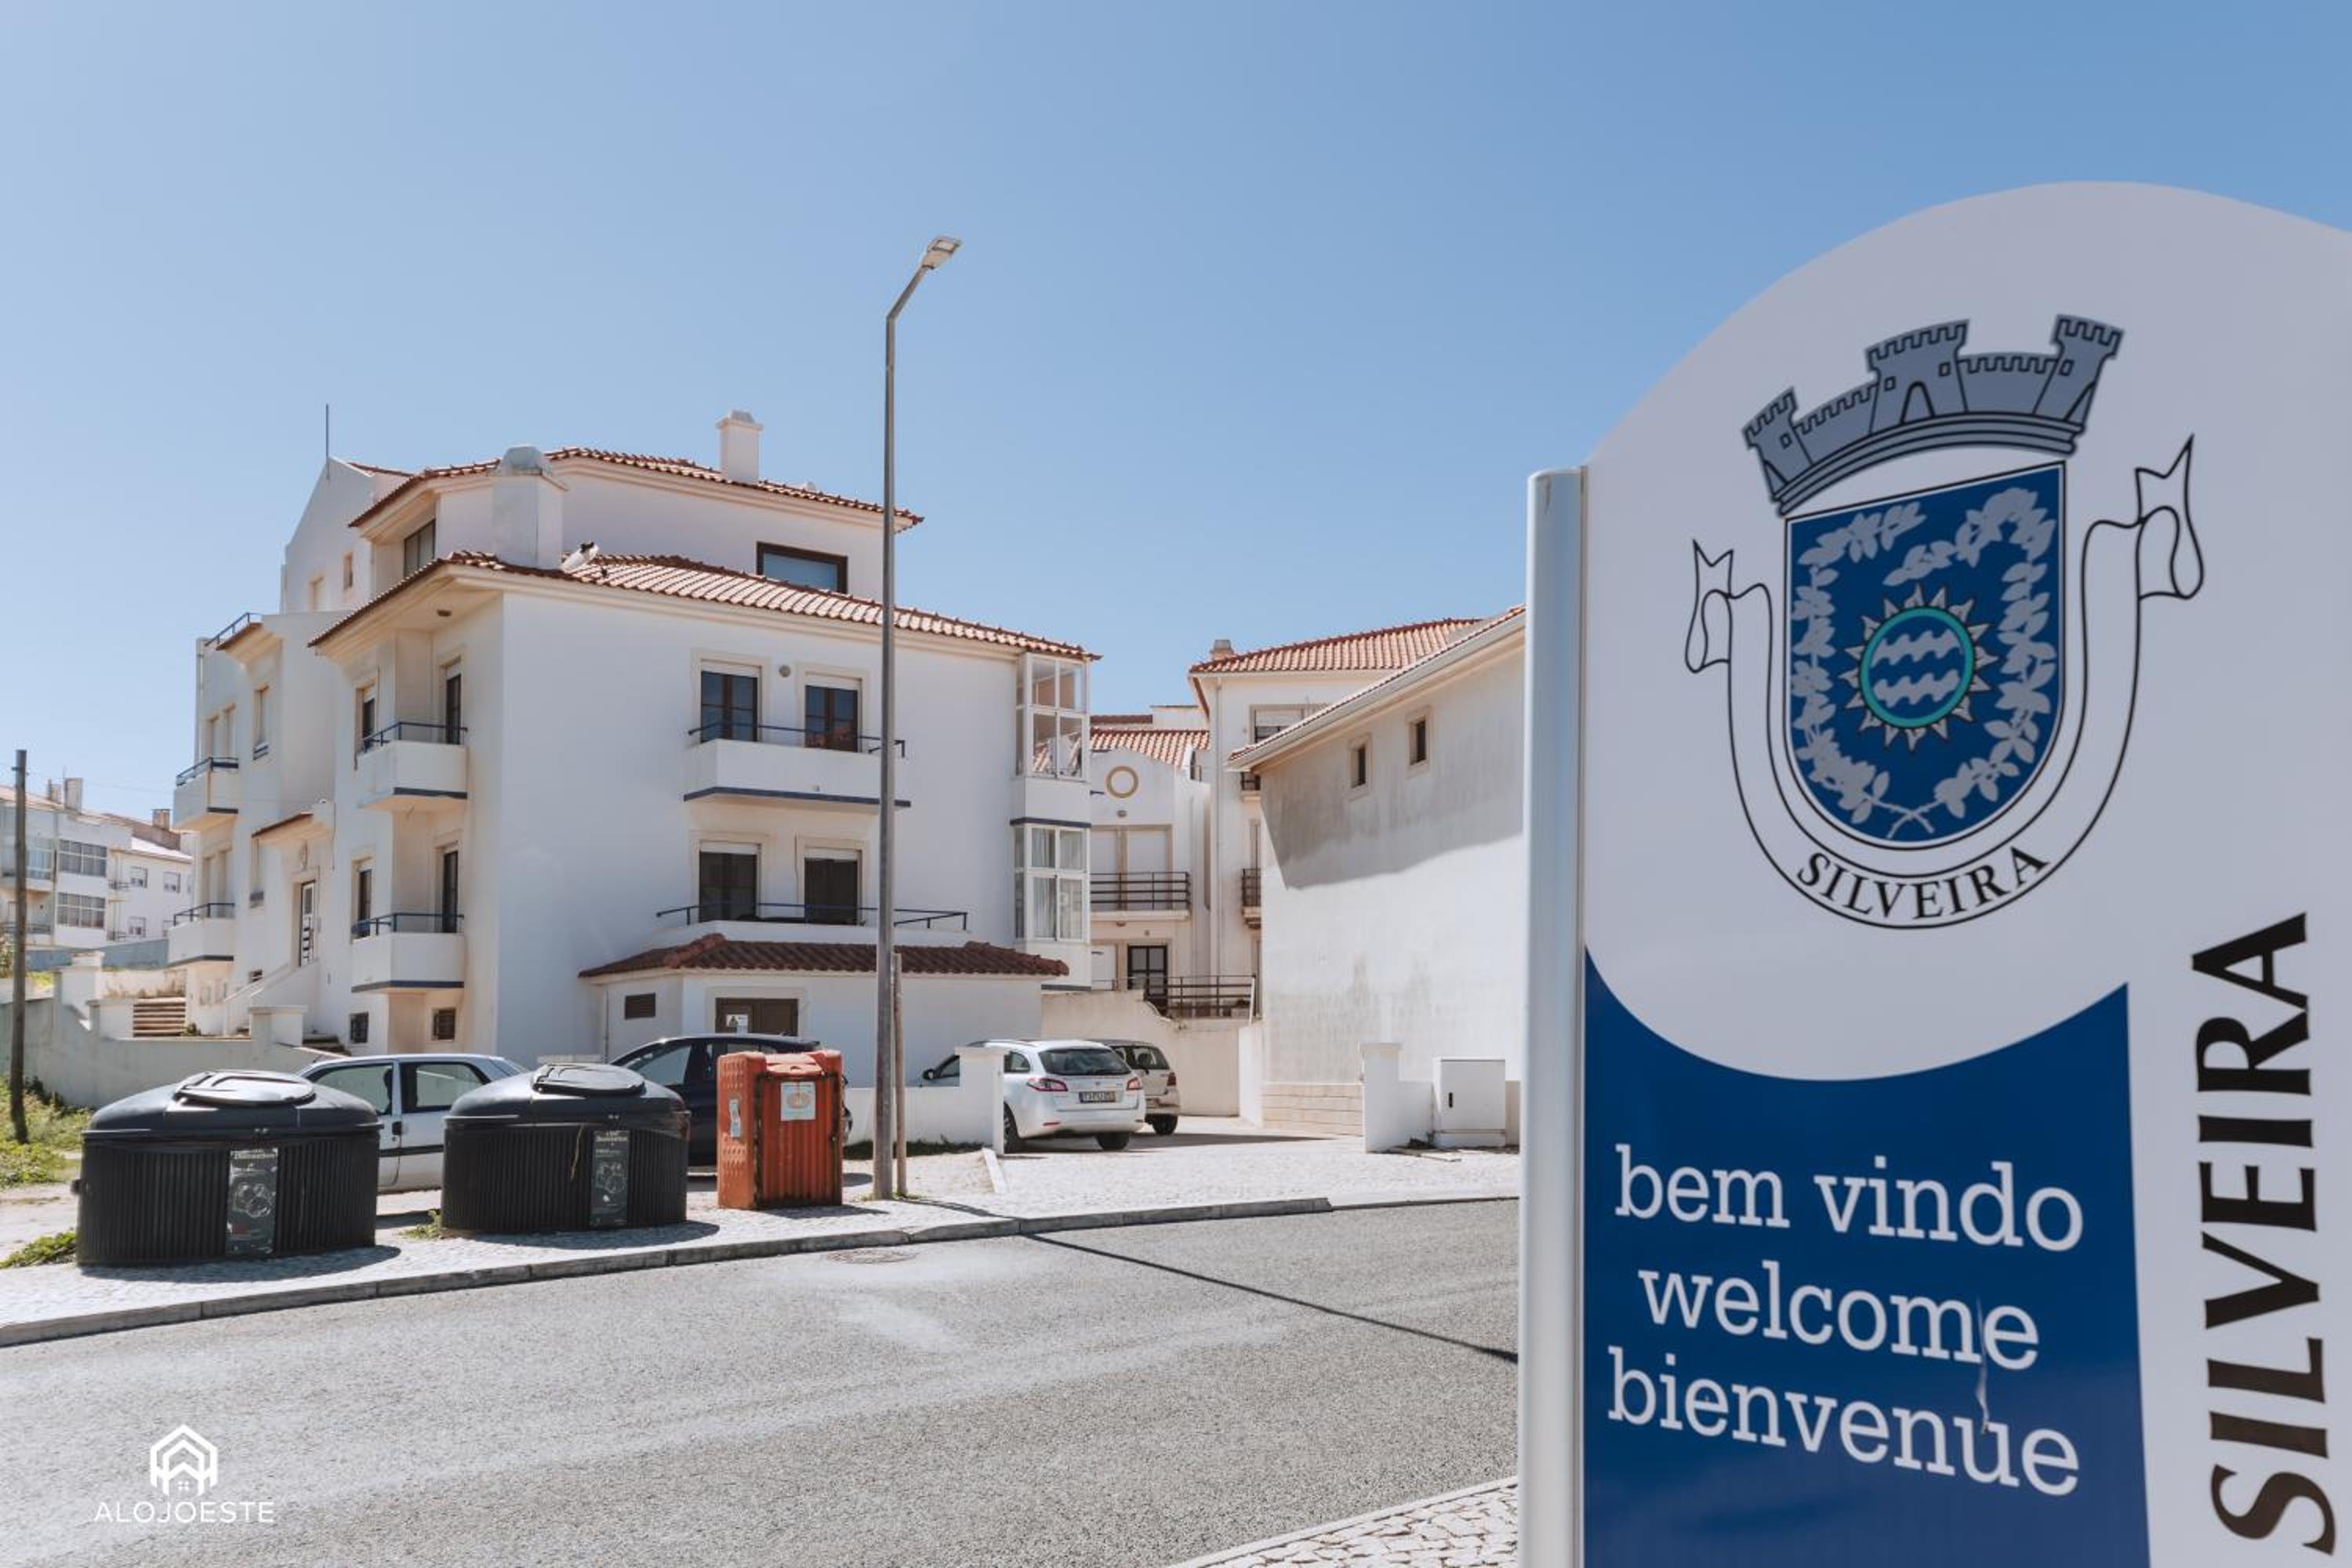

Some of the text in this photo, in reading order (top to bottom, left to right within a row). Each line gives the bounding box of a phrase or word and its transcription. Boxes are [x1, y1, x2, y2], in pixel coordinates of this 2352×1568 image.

[1796, 845, 2050, 920] SILVEIRA
[1614, 1144, 2084, 1251] bem vindo
[2191, 913, 2336, 1555] SILVEIRA
[1638, 1260, 2039, 1370] welcome
[1608, 1345, 2079, 1496] bienvenue
